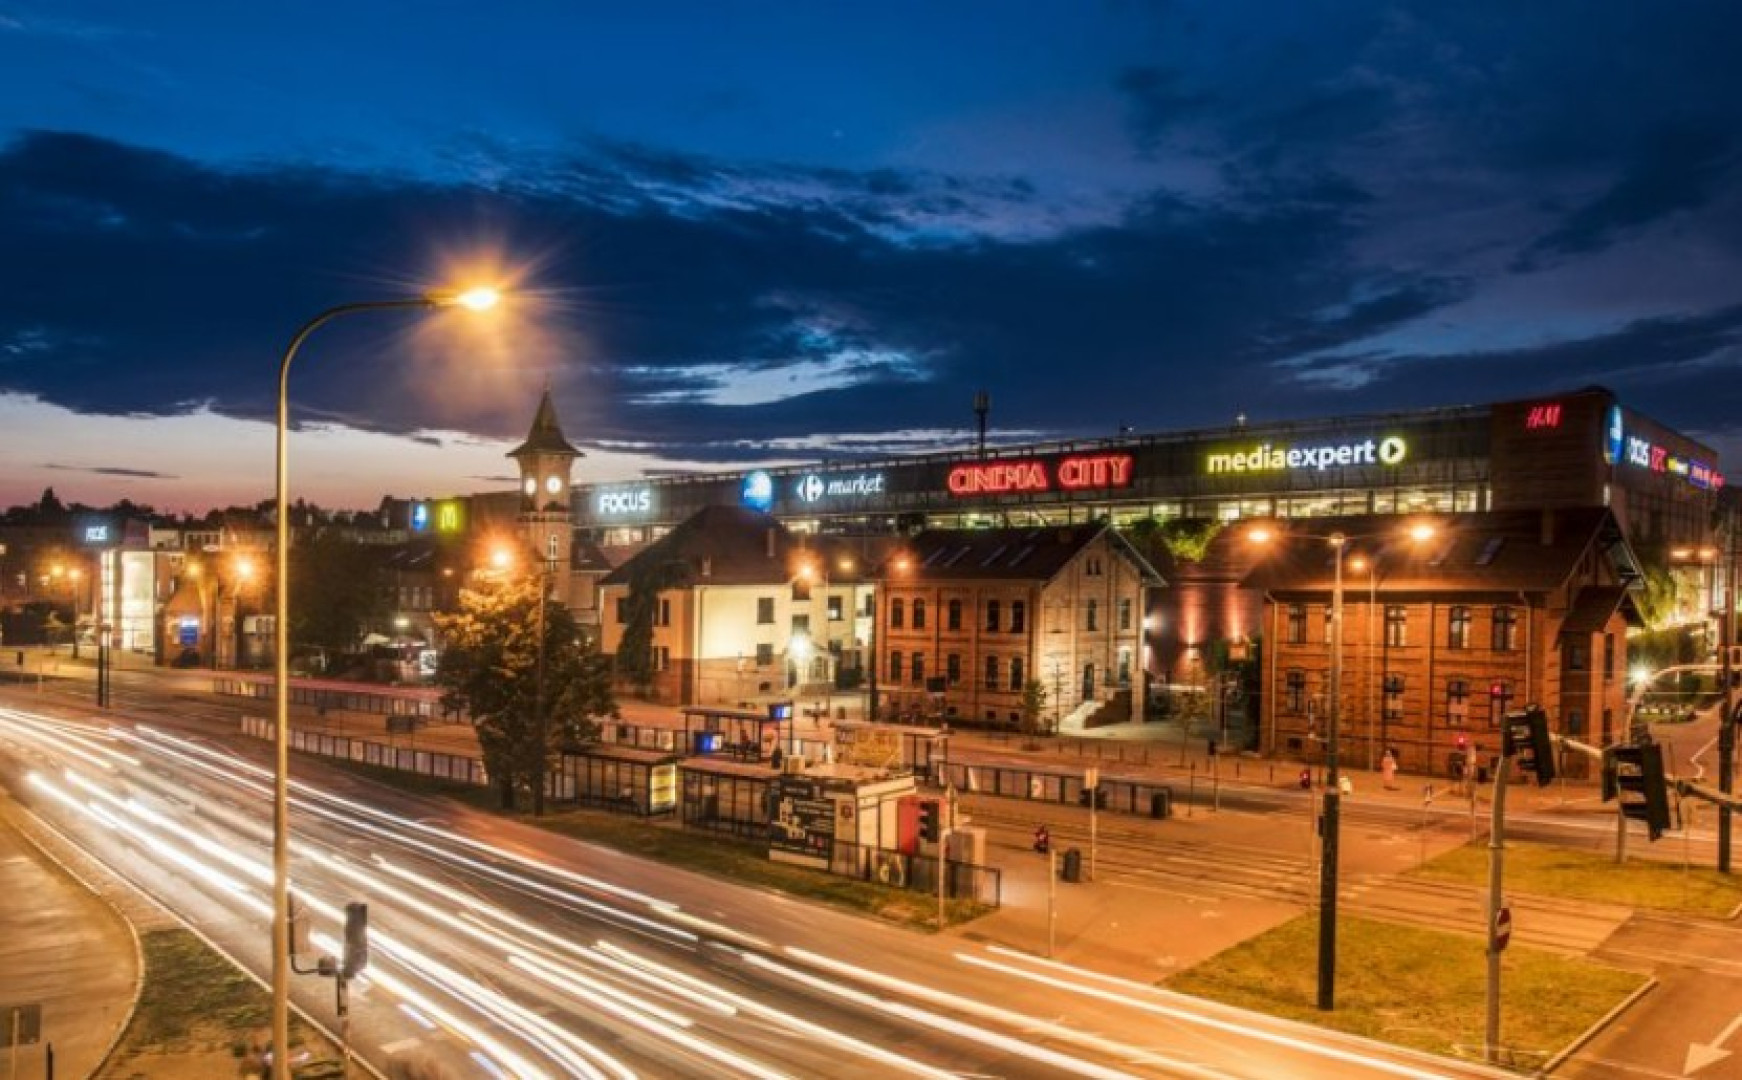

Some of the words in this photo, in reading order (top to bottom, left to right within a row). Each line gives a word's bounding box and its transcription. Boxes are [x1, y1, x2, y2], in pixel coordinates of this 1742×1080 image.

[1208, 440, 1375, 472] mediaexpert
[827, 473, 882, 495] market
[948, 462, 1048, 494] CINEMA
[1058, 455, 1132, 488] CITY
[600, 490, 650, 513] FOCUS
